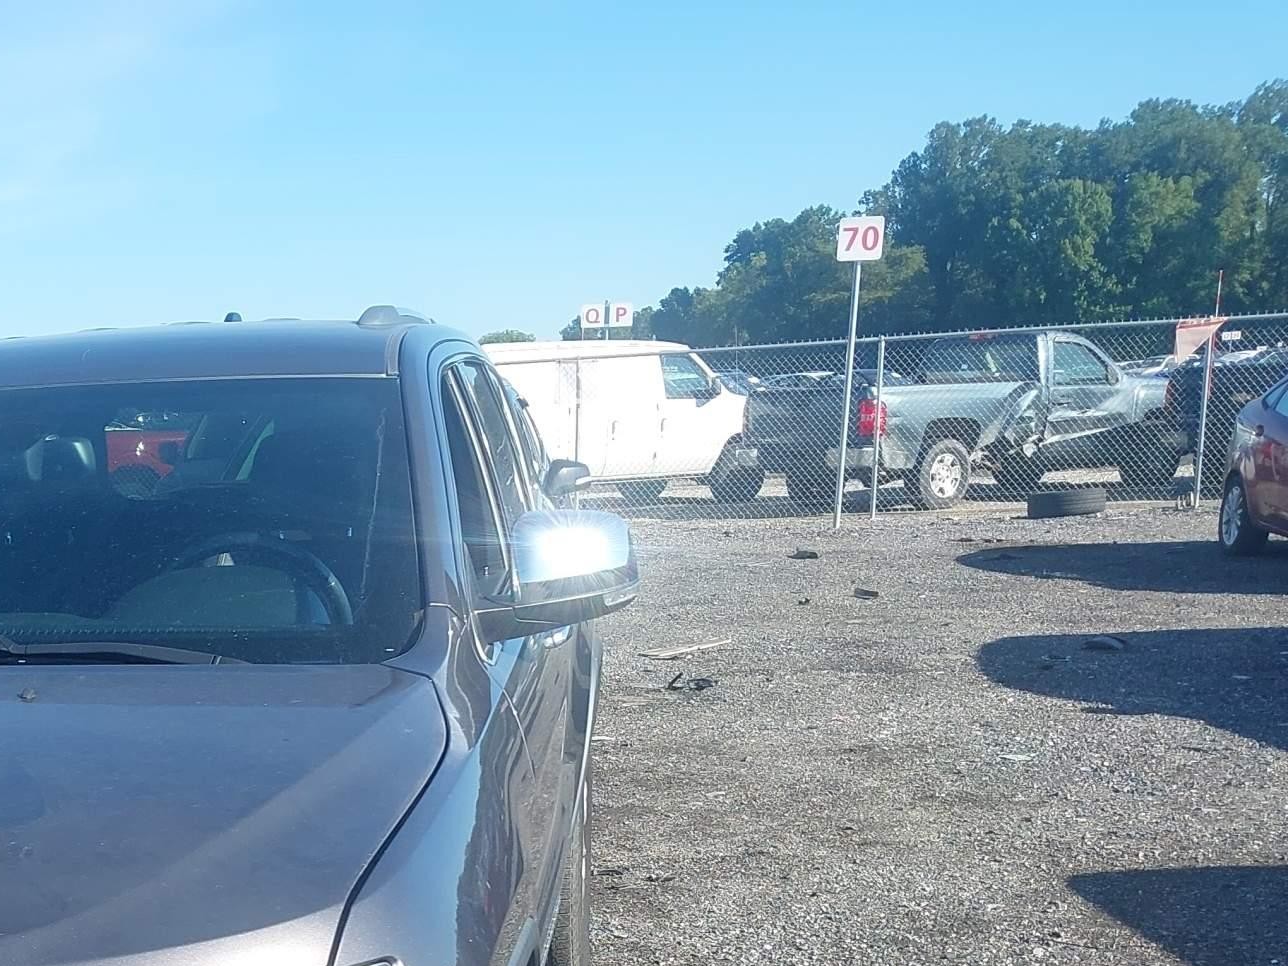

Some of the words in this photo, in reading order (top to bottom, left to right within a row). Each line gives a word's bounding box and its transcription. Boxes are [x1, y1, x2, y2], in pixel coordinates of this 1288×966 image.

[843, 226, 879, 251] 70
[585, 308, 600, 323] Q
[615, 307, 627, 322] P
